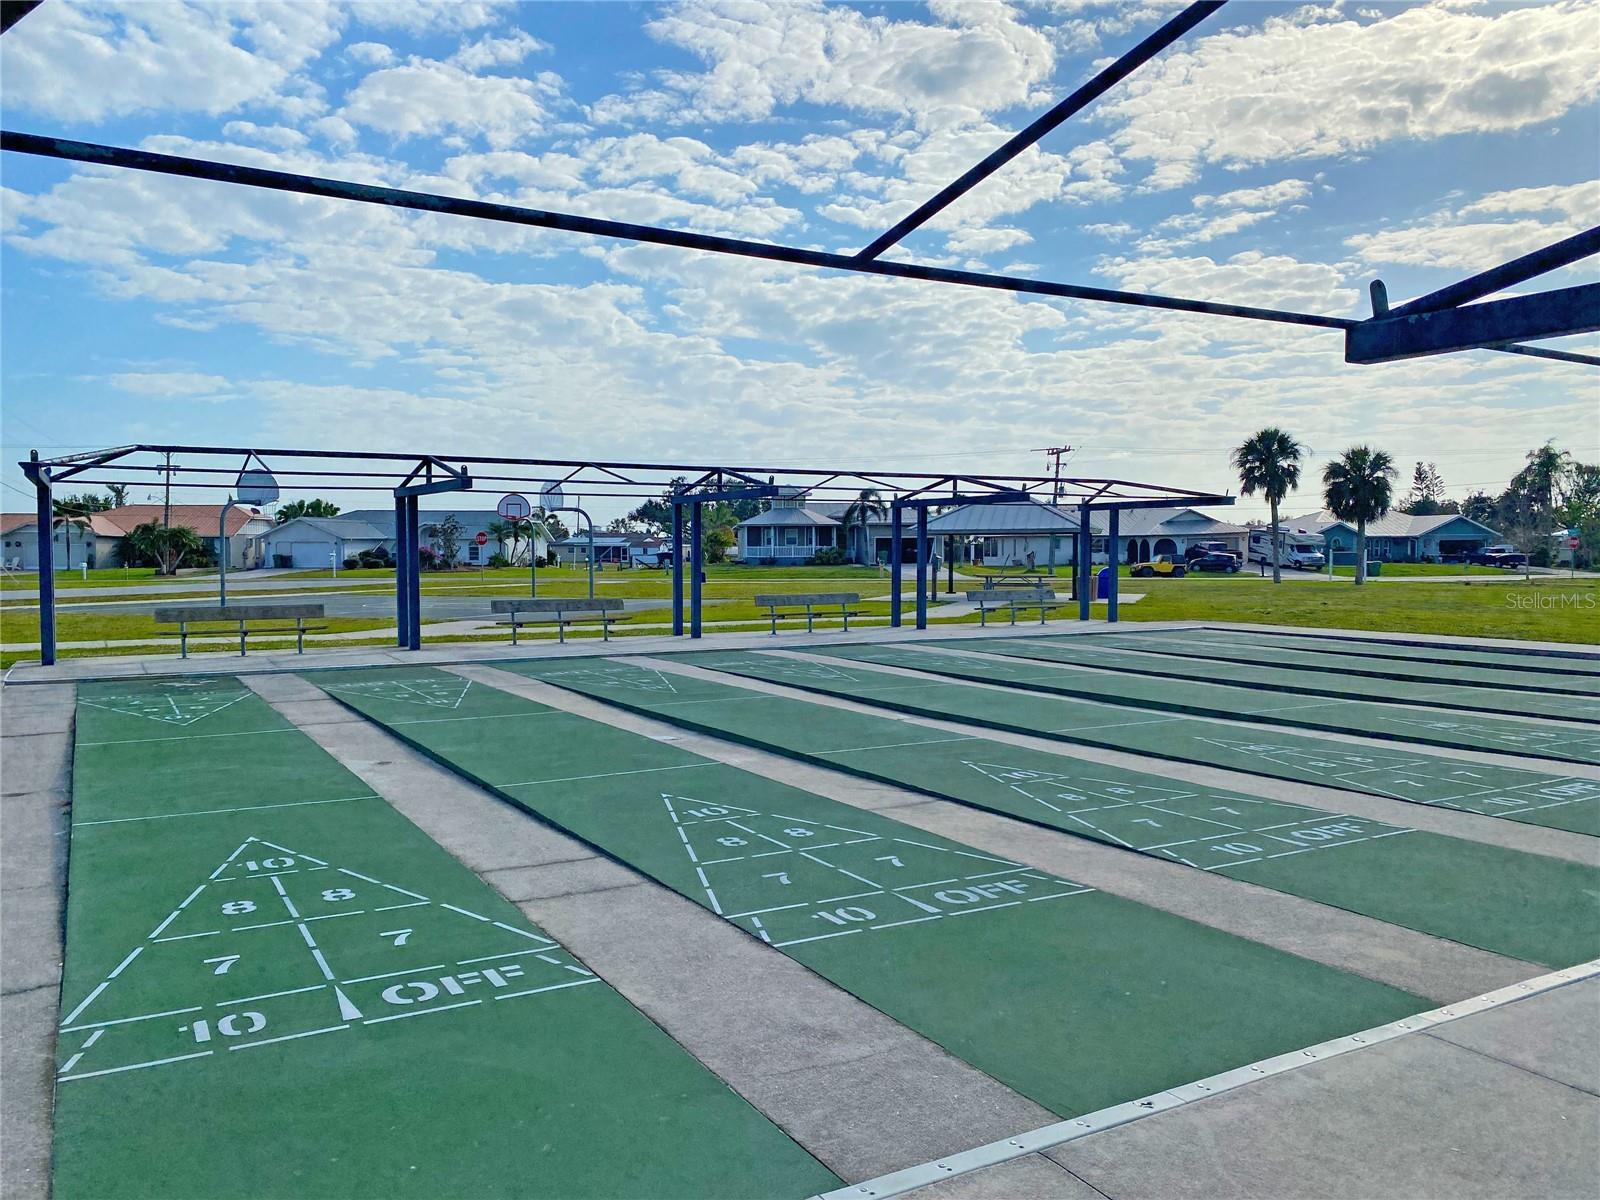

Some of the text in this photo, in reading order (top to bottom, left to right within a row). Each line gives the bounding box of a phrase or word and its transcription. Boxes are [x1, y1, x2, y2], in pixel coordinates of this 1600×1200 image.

[682, 806, 729, 818] 10
[1208, 806, 1241, 815] 7
[1129, 818, 1163, 828] 7
[783, 827, 815, 838] 8
[1209, 822, 1365, 856] 10 OFF
[715, 836, 749, 848] 8
[235, 857, 295, 871] 10
[873, 855, 905, 867] 7
[760, 871, 792, 885] 7
[321, 888, 356, 902] 8
[221, 900, 258, 915] 8
[811, 879, 1030, 926] 10 OFF
[379, 929, 413, 946] 7
[203, 954, 241, 975] 7
[178, 964, 525, 1042] 10 OFF
